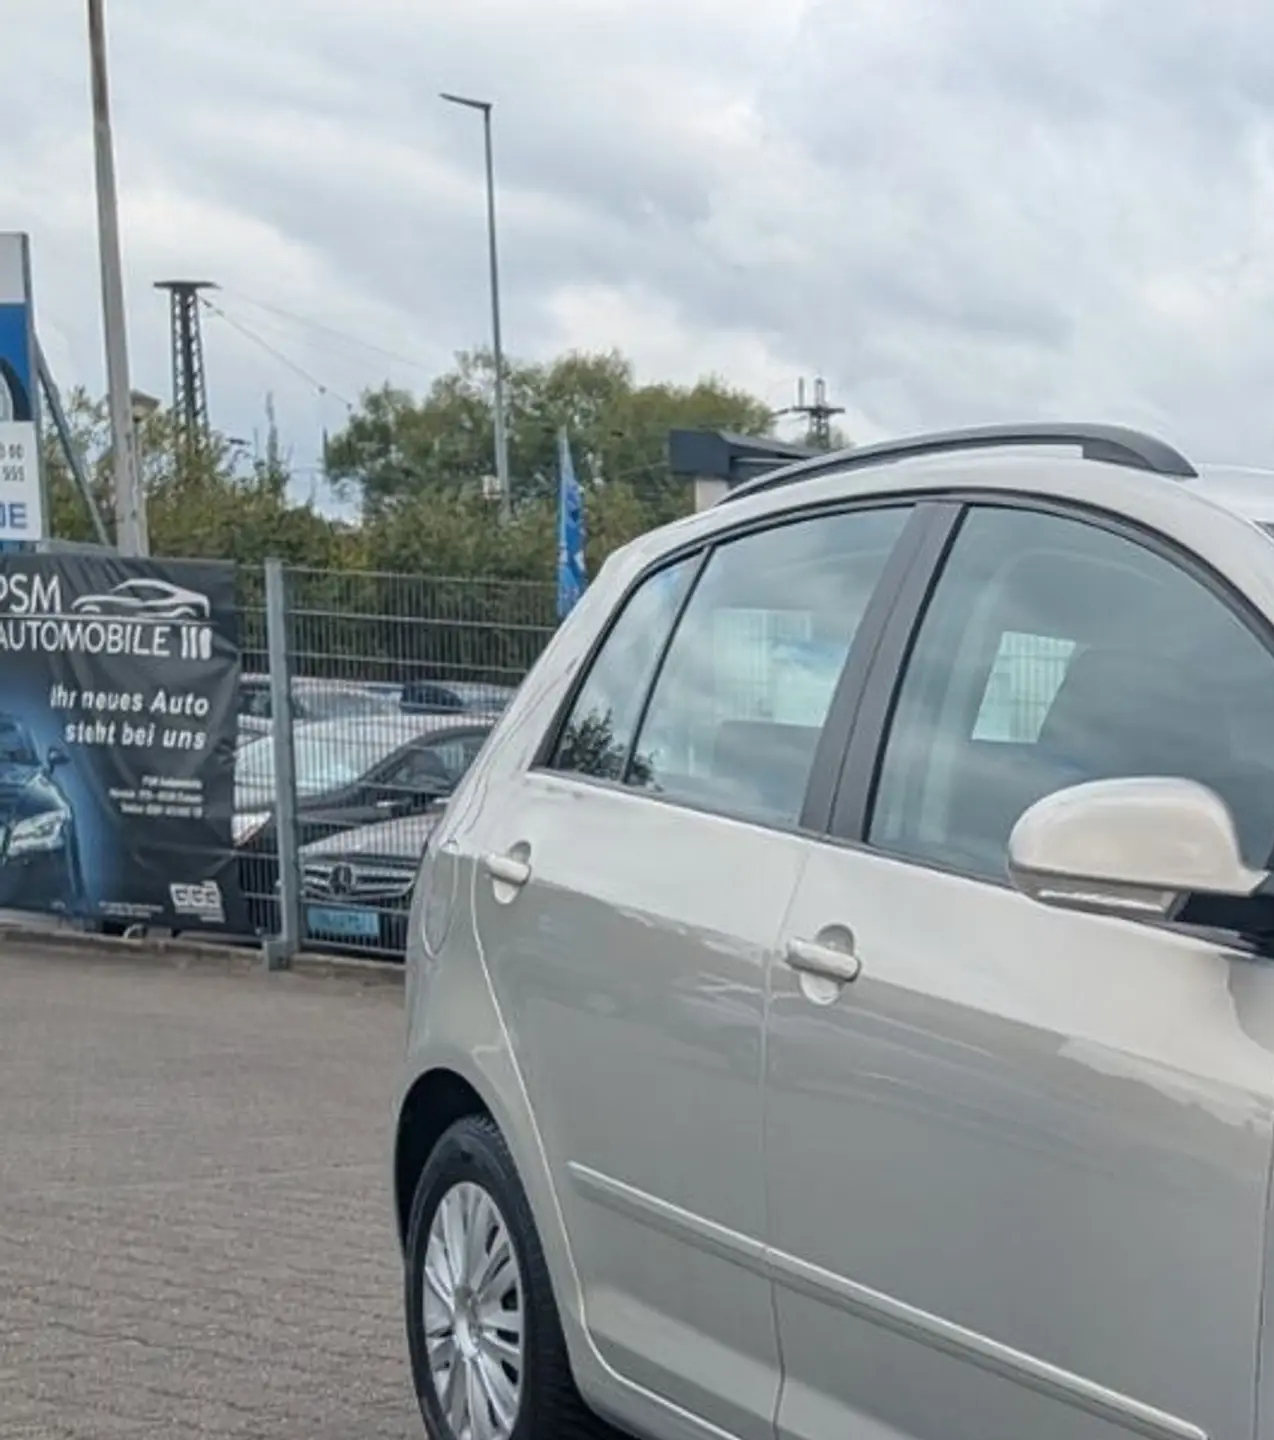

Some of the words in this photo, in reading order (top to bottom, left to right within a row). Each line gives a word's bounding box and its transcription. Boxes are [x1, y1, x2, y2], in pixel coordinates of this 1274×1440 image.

[0, 619, 171, 657] AUTOMOBILE
[50, 683, 77, 709] Ihr
[82, 690, 144, 712] neues
[151, 688, 210, 716] Auto
[65, 720, 116, 745] steht
[122, 721, 155, 747] bei
[163, 729, 207, 751] uns
